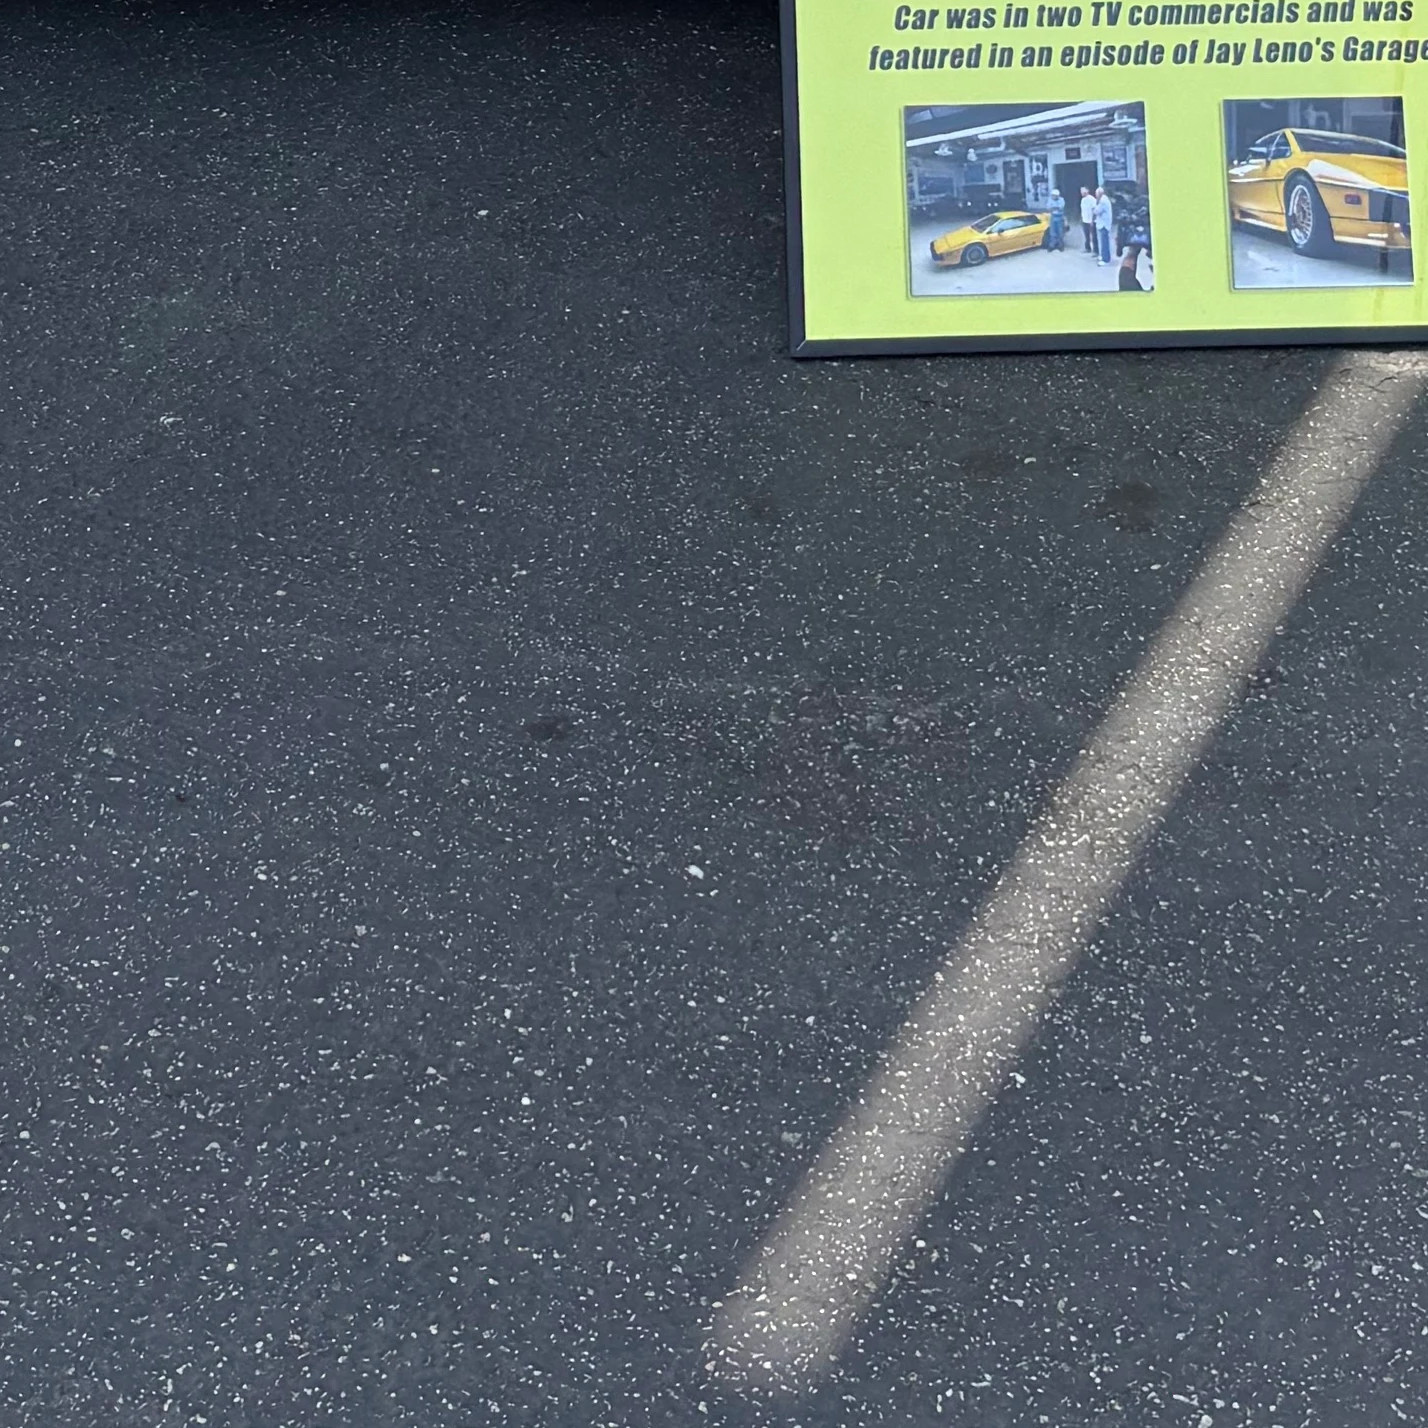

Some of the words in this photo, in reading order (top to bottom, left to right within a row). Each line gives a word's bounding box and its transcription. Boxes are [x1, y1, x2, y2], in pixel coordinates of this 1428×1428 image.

[894, 4, 940, 32] Car
[945, 7, 998, 30] was
[1002, 2, 1030, 29] in
[1035, 3, 1083, 28] two
[1089, 0, 1123, 27] TV
[1362, 0, 1414, 23] was
[868, 42, 983, 71] featured
[987, 42, 1015, 69] in
[1020, 45, 1054, 68] an
[1059, 39, 1166, 70] episode
[1171, 38, 1200, 66] of
[1202, 38, 1247, 67] Jay
[1251, 36, 1336, 64] Leno's
